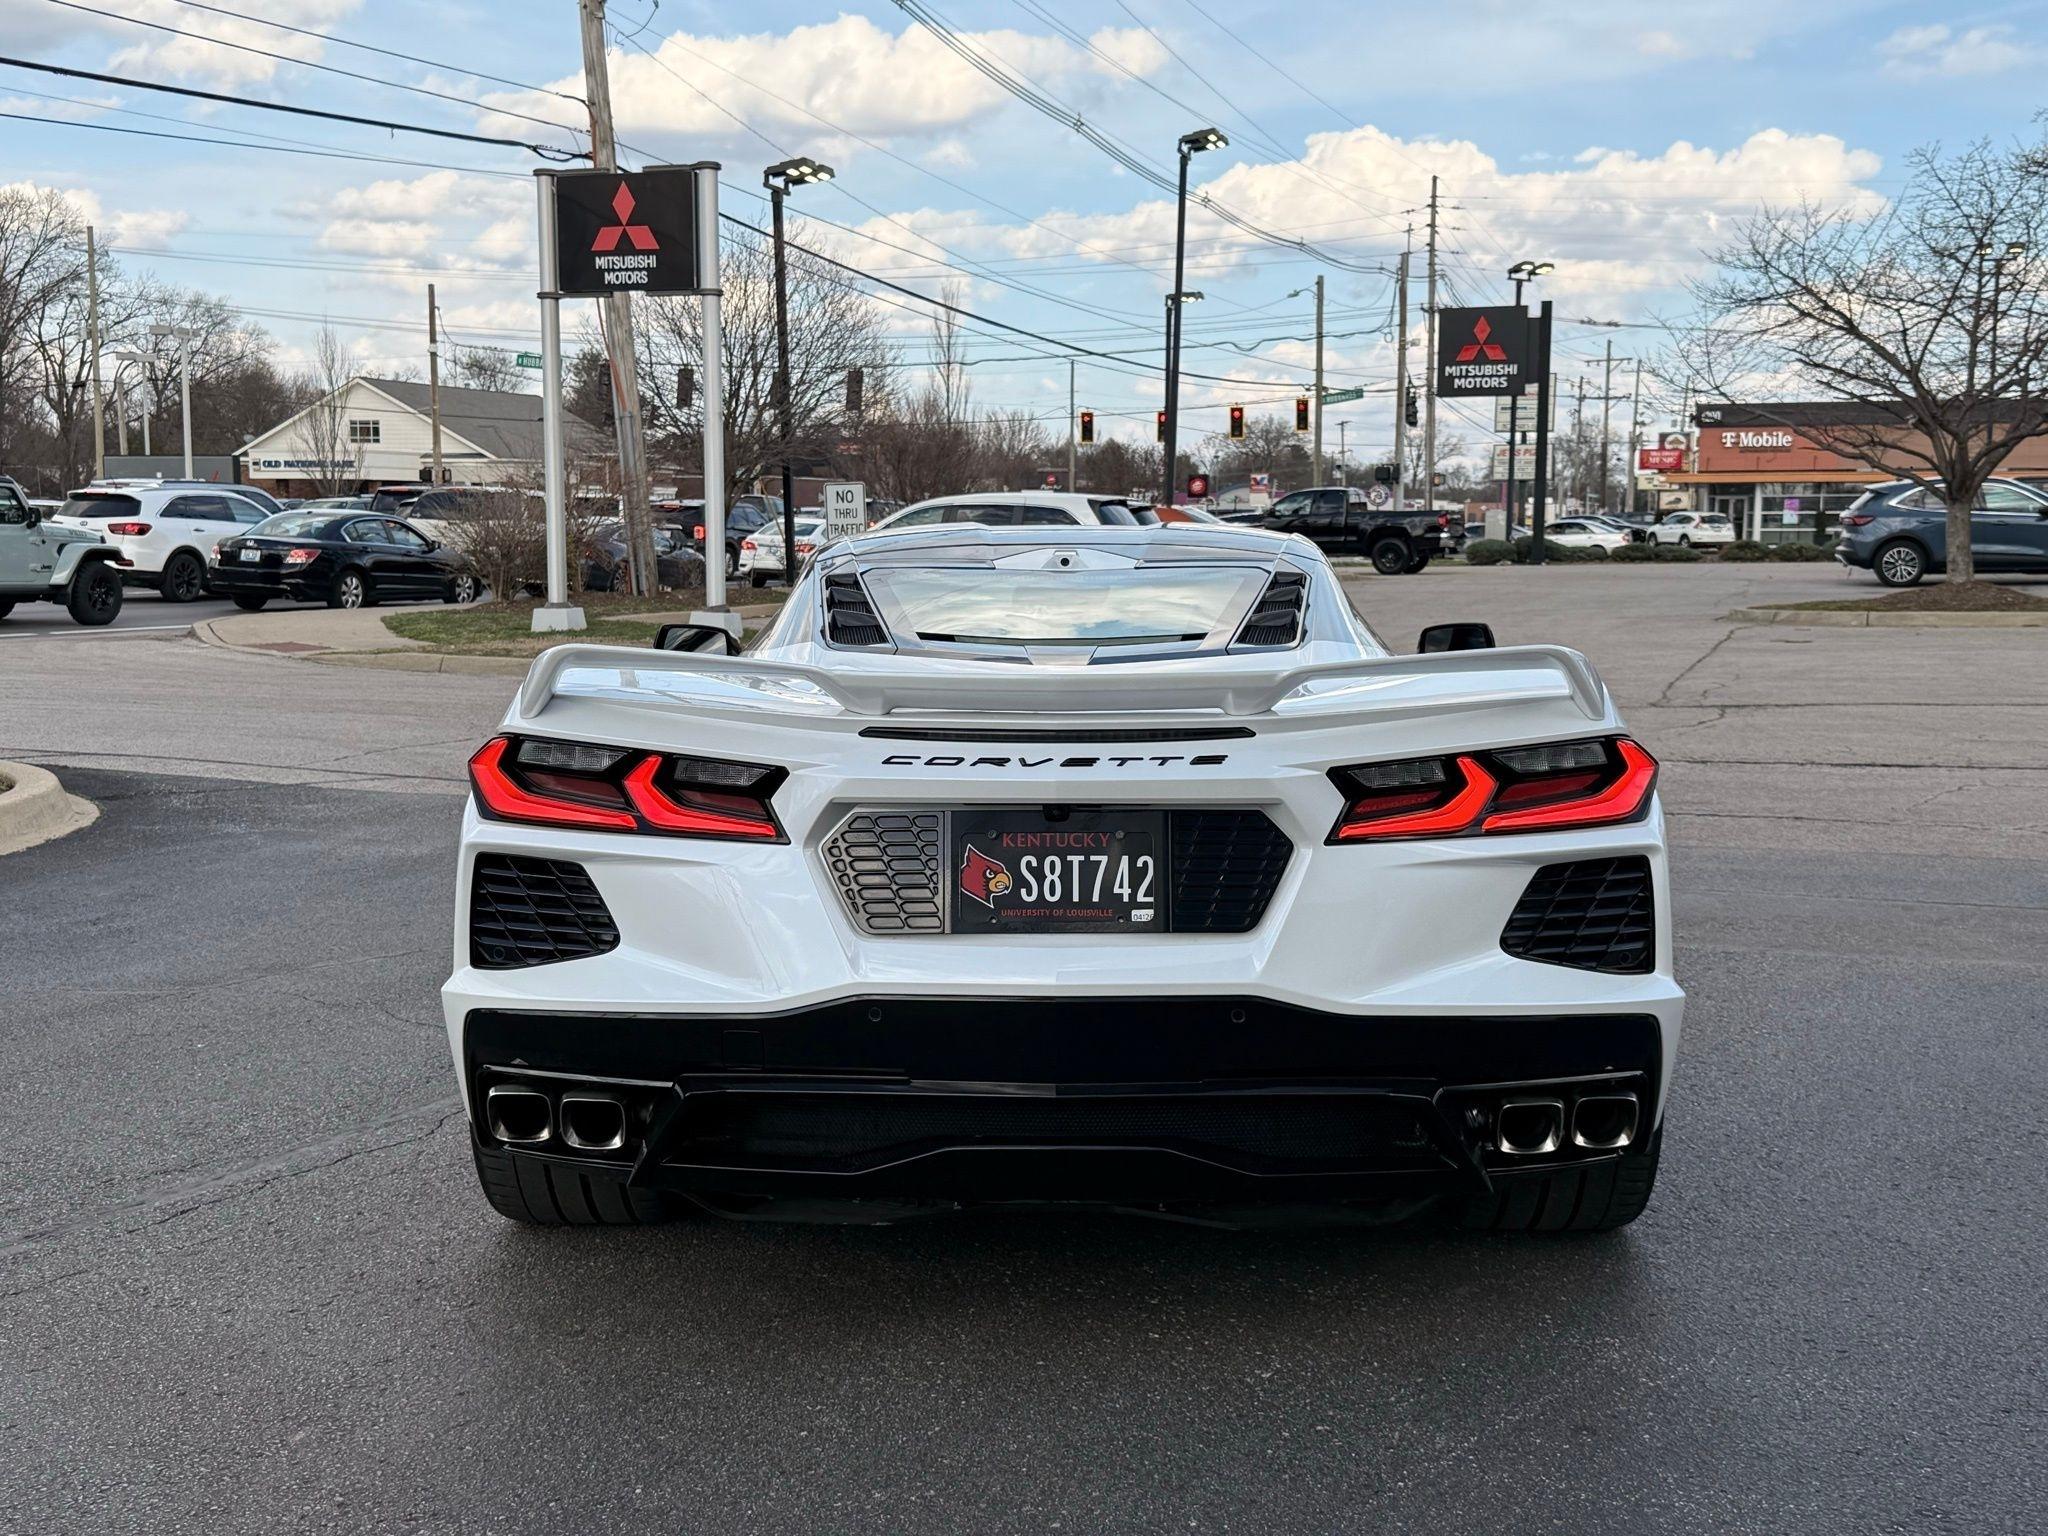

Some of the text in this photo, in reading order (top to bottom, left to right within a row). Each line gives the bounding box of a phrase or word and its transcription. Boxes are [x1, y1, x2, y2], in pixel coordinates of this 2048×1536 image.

[595, 254, 657, 270] MITSUBISHI
[604, 271, 649, 285] MOTORS
[1444, 363, 1518, 377] MITSUBISHI
[1453, 377, 1509, 389] MOTORS
[262, 460, 281, 469] OLD
[836, 490, 854, 504] NO
[834, 507, 858, 519] THRU
[881, 754, 1230, 769] CORVETTE
[1002, 832, 1112, 848] KENTUCKY
[1020, 854, 1154, 903] S8T742
[1001, 908, 1113, 918] UNIVERSITY OF LOUISVILLE
